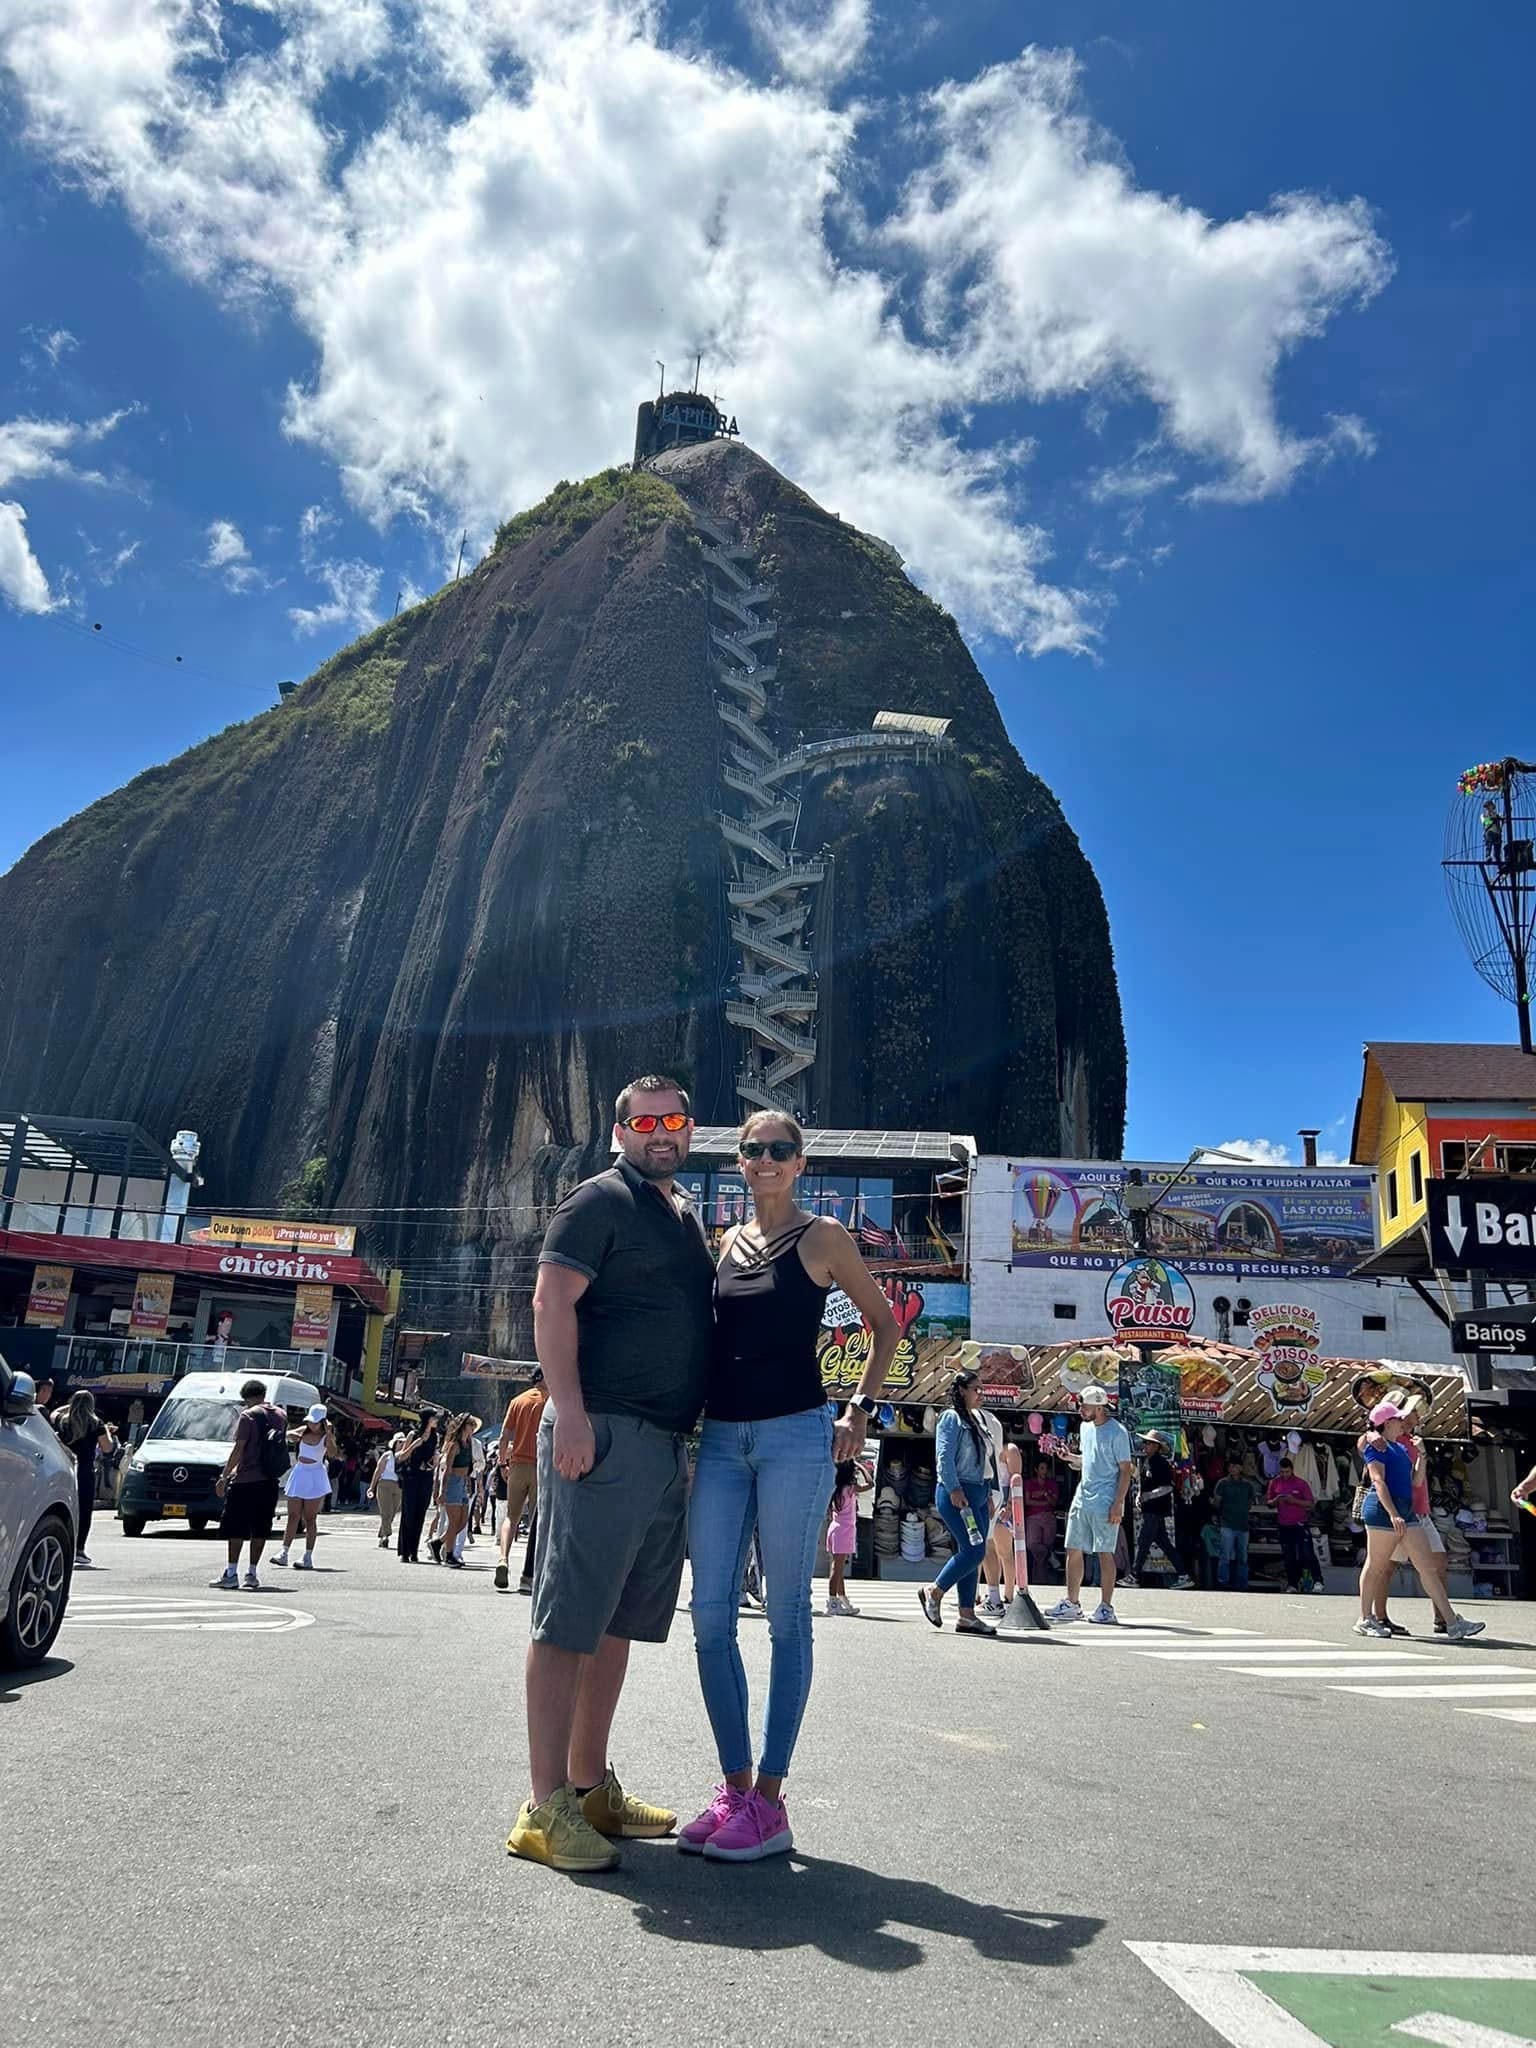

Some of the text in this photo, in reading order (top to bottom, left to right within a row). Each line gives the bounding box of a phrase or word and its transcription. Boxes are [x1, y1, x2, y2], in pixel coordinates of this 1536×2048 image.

[1148, 1172, 1198, 1185] FOTOS
[1205, 1177, 1228, 1186] QUE
[1230, 1177, 1248, 1186] NO
[1251, 1178, 1263, 1187] TE
[1266, 1179, 1307, 1187] PUEDEN
[1311, 1179, 1352, 1188] FALTAR
[1181, 1197, 1226, 1208] RECUERDOS
[1282, 1206, 1306, 1215] LAS
[213, 1223, 229, 1234] Que
[230, 1224, 251, 1236] buen
[251, 1225, 272, 1238] pollo
[1475, 1202, 1536, 1246] Ba
[1050, 1255, 1077, 1266] QUE
[1084, 1257, 1103, 1267] NO
[1190, 1261, 1235, 1272] ESTOS
[1241, 1264, 1331, 1275] RECUERDOS
[835, 1308, 862, 1321] VIDEO
[1108, 1296, 1192, 1327] Paisa
[1251, 1304, 1316, 1322] DELICIOSA
[1119, 1330, 1185, 1340] RESTAURANTE BAR
[1465, 1323, 1527, 1342] Baños
[845, 1328, 913, 1358] Mo
[821, 1345, 915, 1384] Gigte
[1262, 1348, 1319, 1372] 3 PISOS
